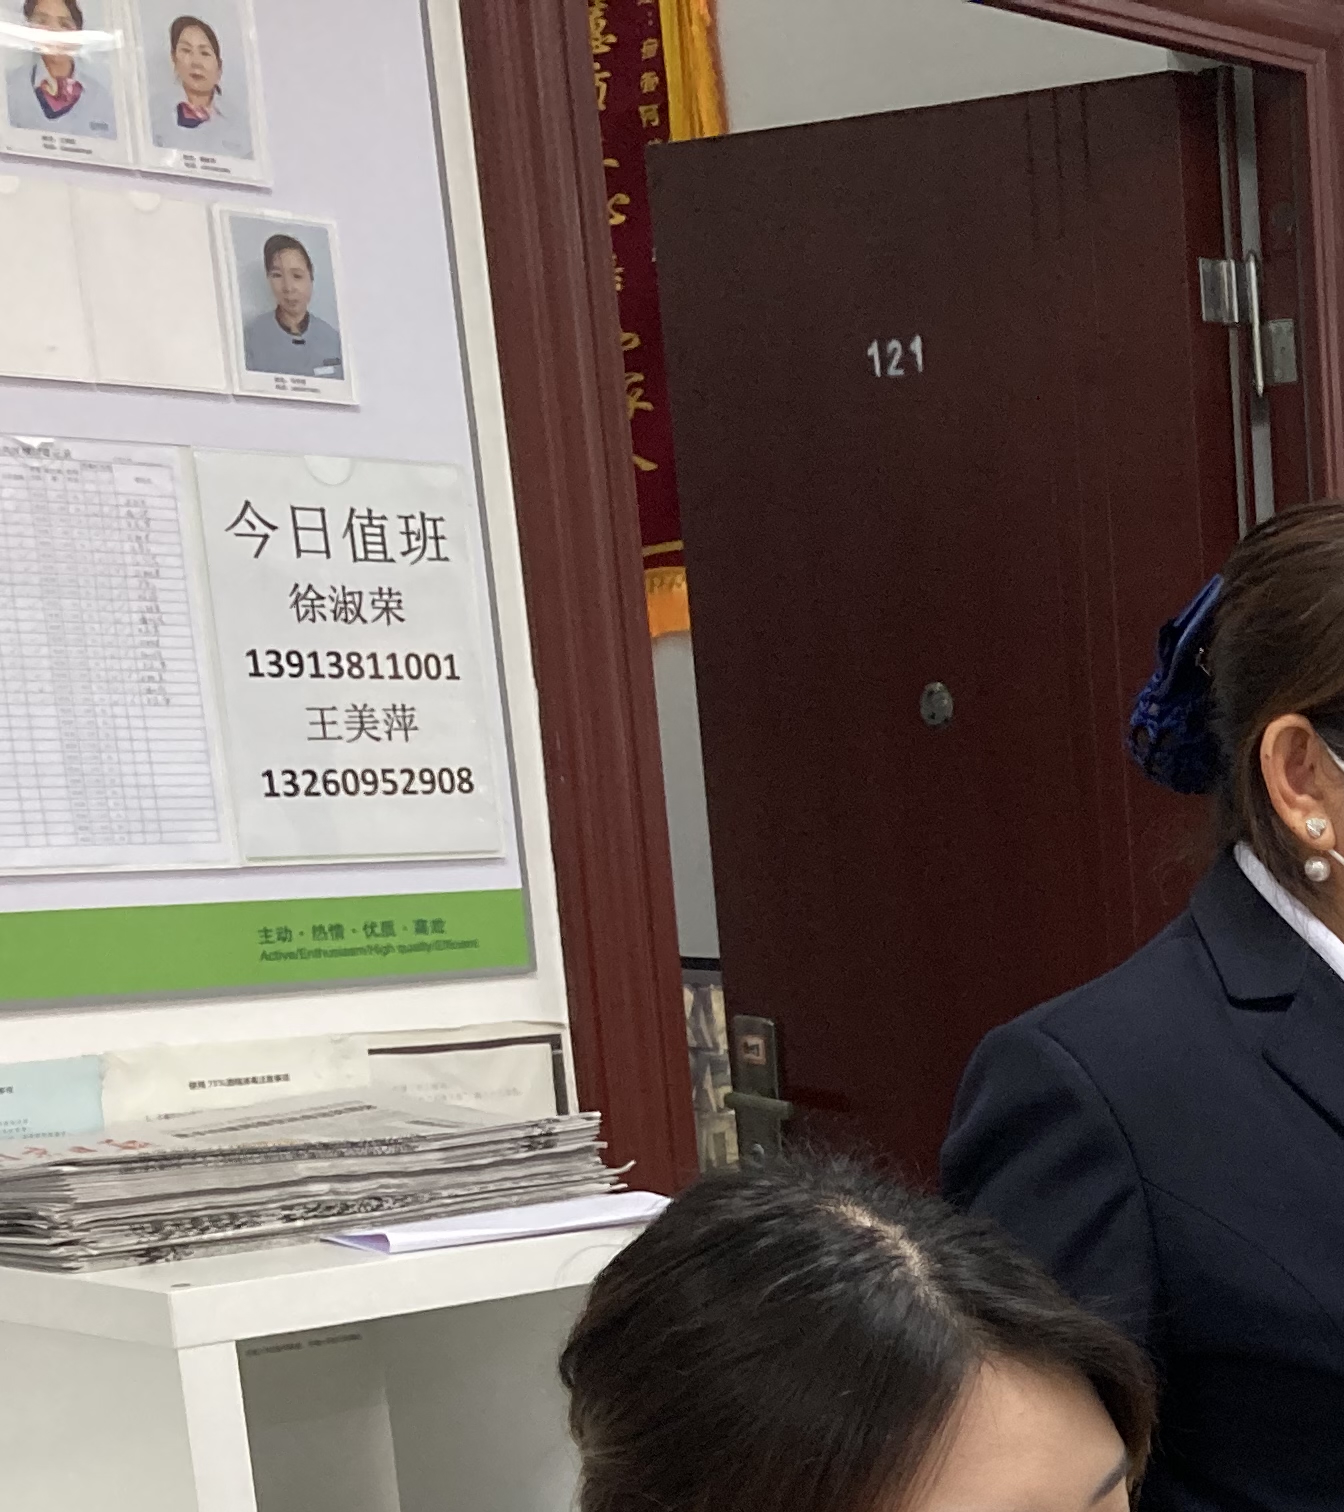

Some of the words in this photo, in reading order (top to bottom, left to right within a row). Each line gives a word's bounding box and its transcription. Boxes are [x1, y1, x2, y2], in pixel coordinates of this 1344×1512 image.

[867, 335, 923, 378] 121
[225, 499, 451, 565] 今日值班
[288, 582, 405, 626] 徐淑荣
[245, 648, 460, 681] 13913811001
[305, 703, 419, 743] 王美萍
[261, 767, 475, 798] 13260952908
